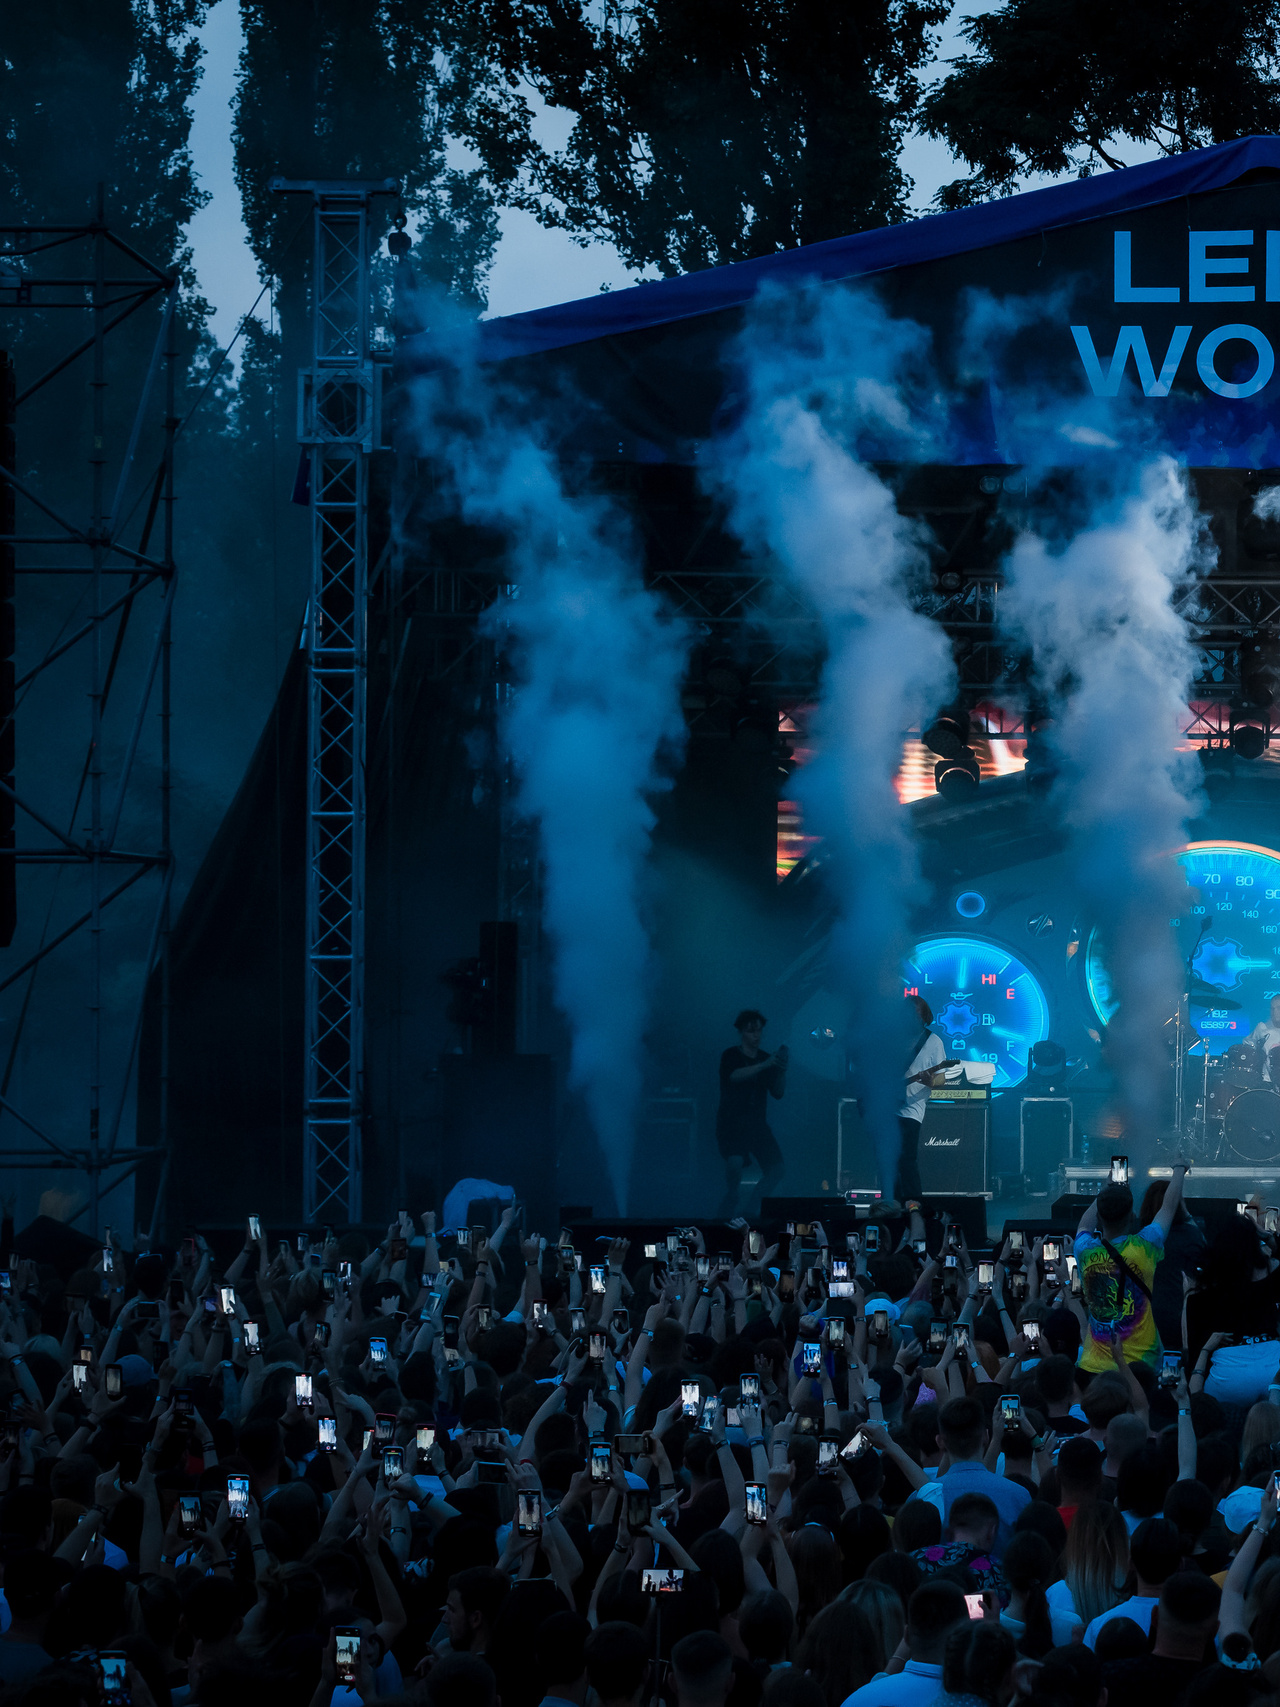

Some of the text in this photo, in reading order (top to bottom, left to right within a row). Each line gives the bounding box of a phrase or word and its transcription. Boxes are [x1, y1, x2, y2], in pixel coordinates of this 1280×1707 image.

[1203, 873, 1221, 884] 70
[1235, 875, 1254, 886] 80
[1190, 905, 1206, 914] 100
[1216, 902, 1233, 911] 120
[1242, 910, 1259, 918] 140
[1261, 925, 1278, 934] 160
[925, 973, 933, 984] L
[981, 974, 997, 985] HI
[903, 987, 918, 997] HI
[1006, 988, 1015, 999] E
[1200, 1021, 1237, 1030] 658973
[1006, 1041, 1015, 1051] F
[924, 1136, 961, 1147] Marshall
